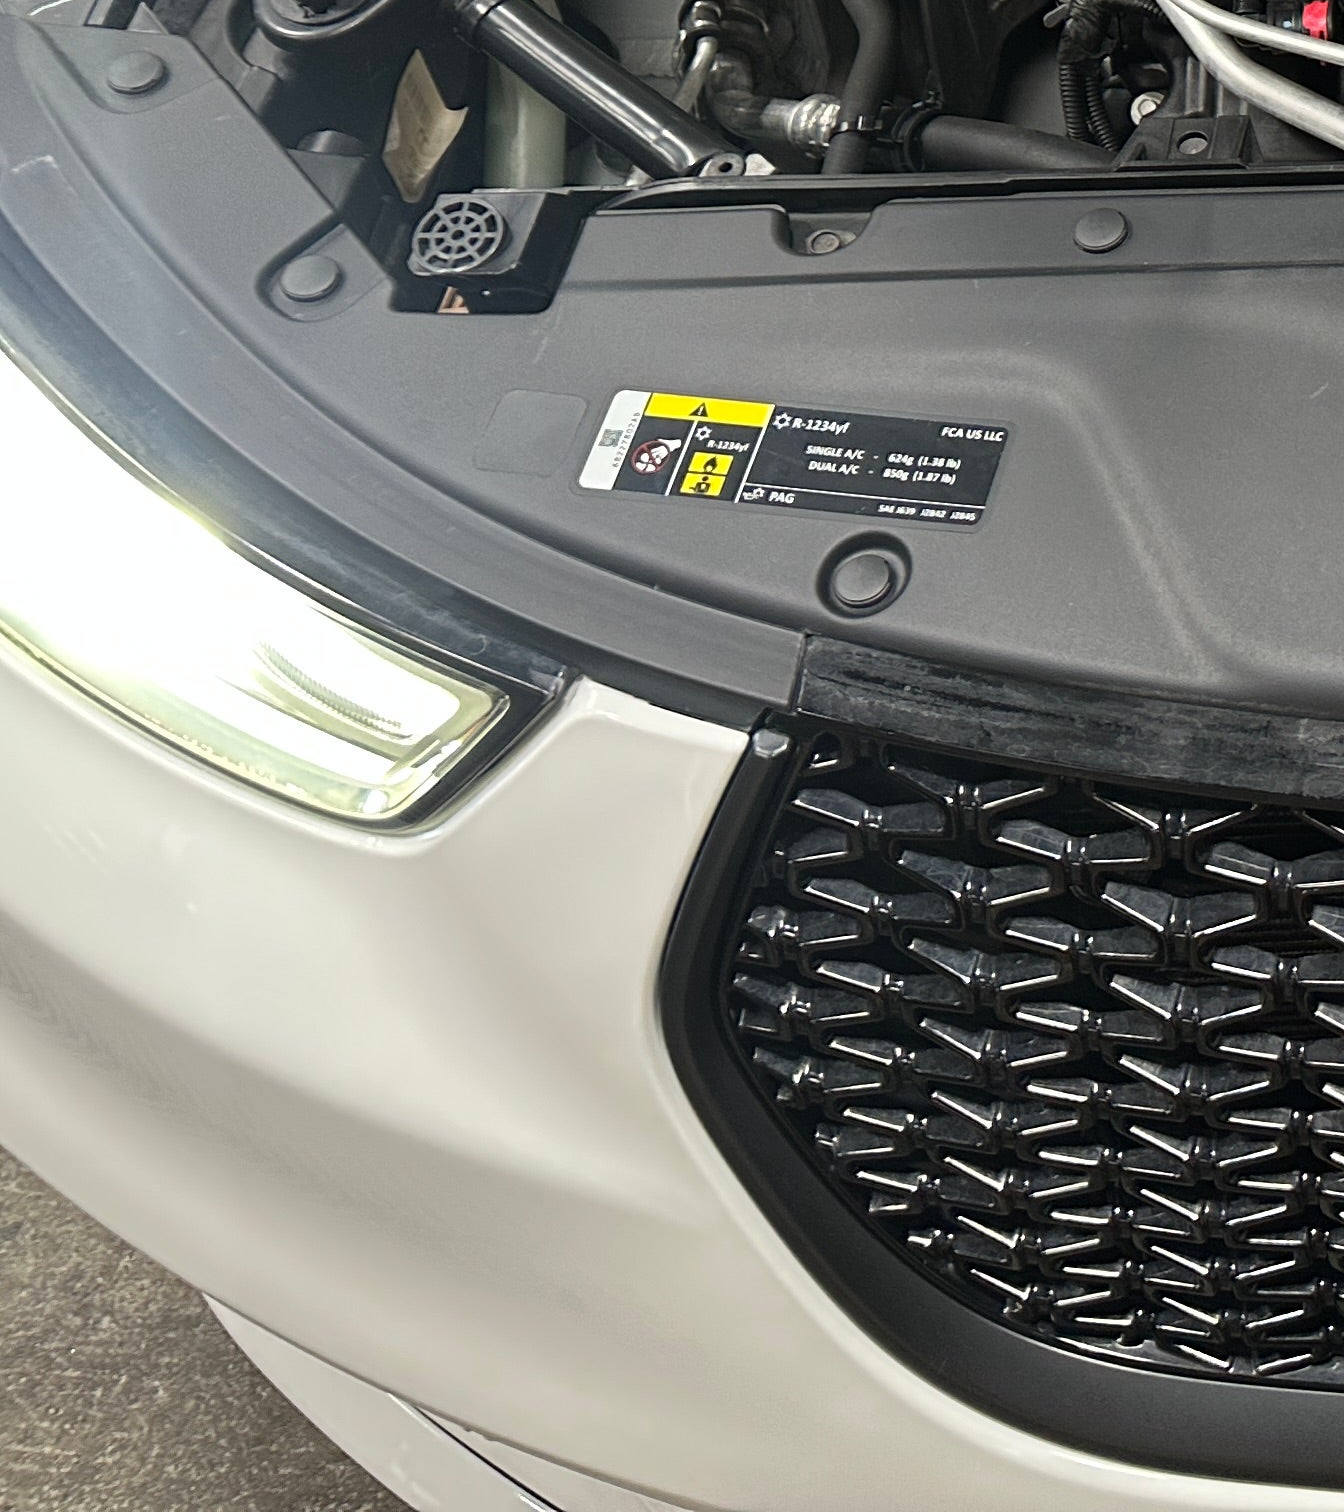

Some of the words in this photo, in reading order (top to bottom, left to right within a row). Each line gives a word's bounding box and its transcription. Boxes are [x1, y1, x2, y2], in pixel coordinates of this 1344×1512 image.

[792, 417, 850, 436] R-1234yf
[941, 426, 964, 438] FCA
[966, 428, 982, 440] US
[984, 431, 1004, 442] LLC
[706, 440, 750, 453] R-1234yf
[806, 445, 843, 458] SINGLE
[844, 448, 865, 460] A/C
[888, 453, 914, 467] 624g
[918, 455, 944, 468] (1.38
[946, 458, 962, 470] lb)
[808, 461, 838, 473] DUAL
[838, 464, 860, 475] A/C
[883, 468, 909, 482] 850g
[912, 470, 940, 484] (1.87
[940, 473, 957, 486] lb)
[768, 491, 796, 505] PAG
[878, 504, 894, 514] SAE
